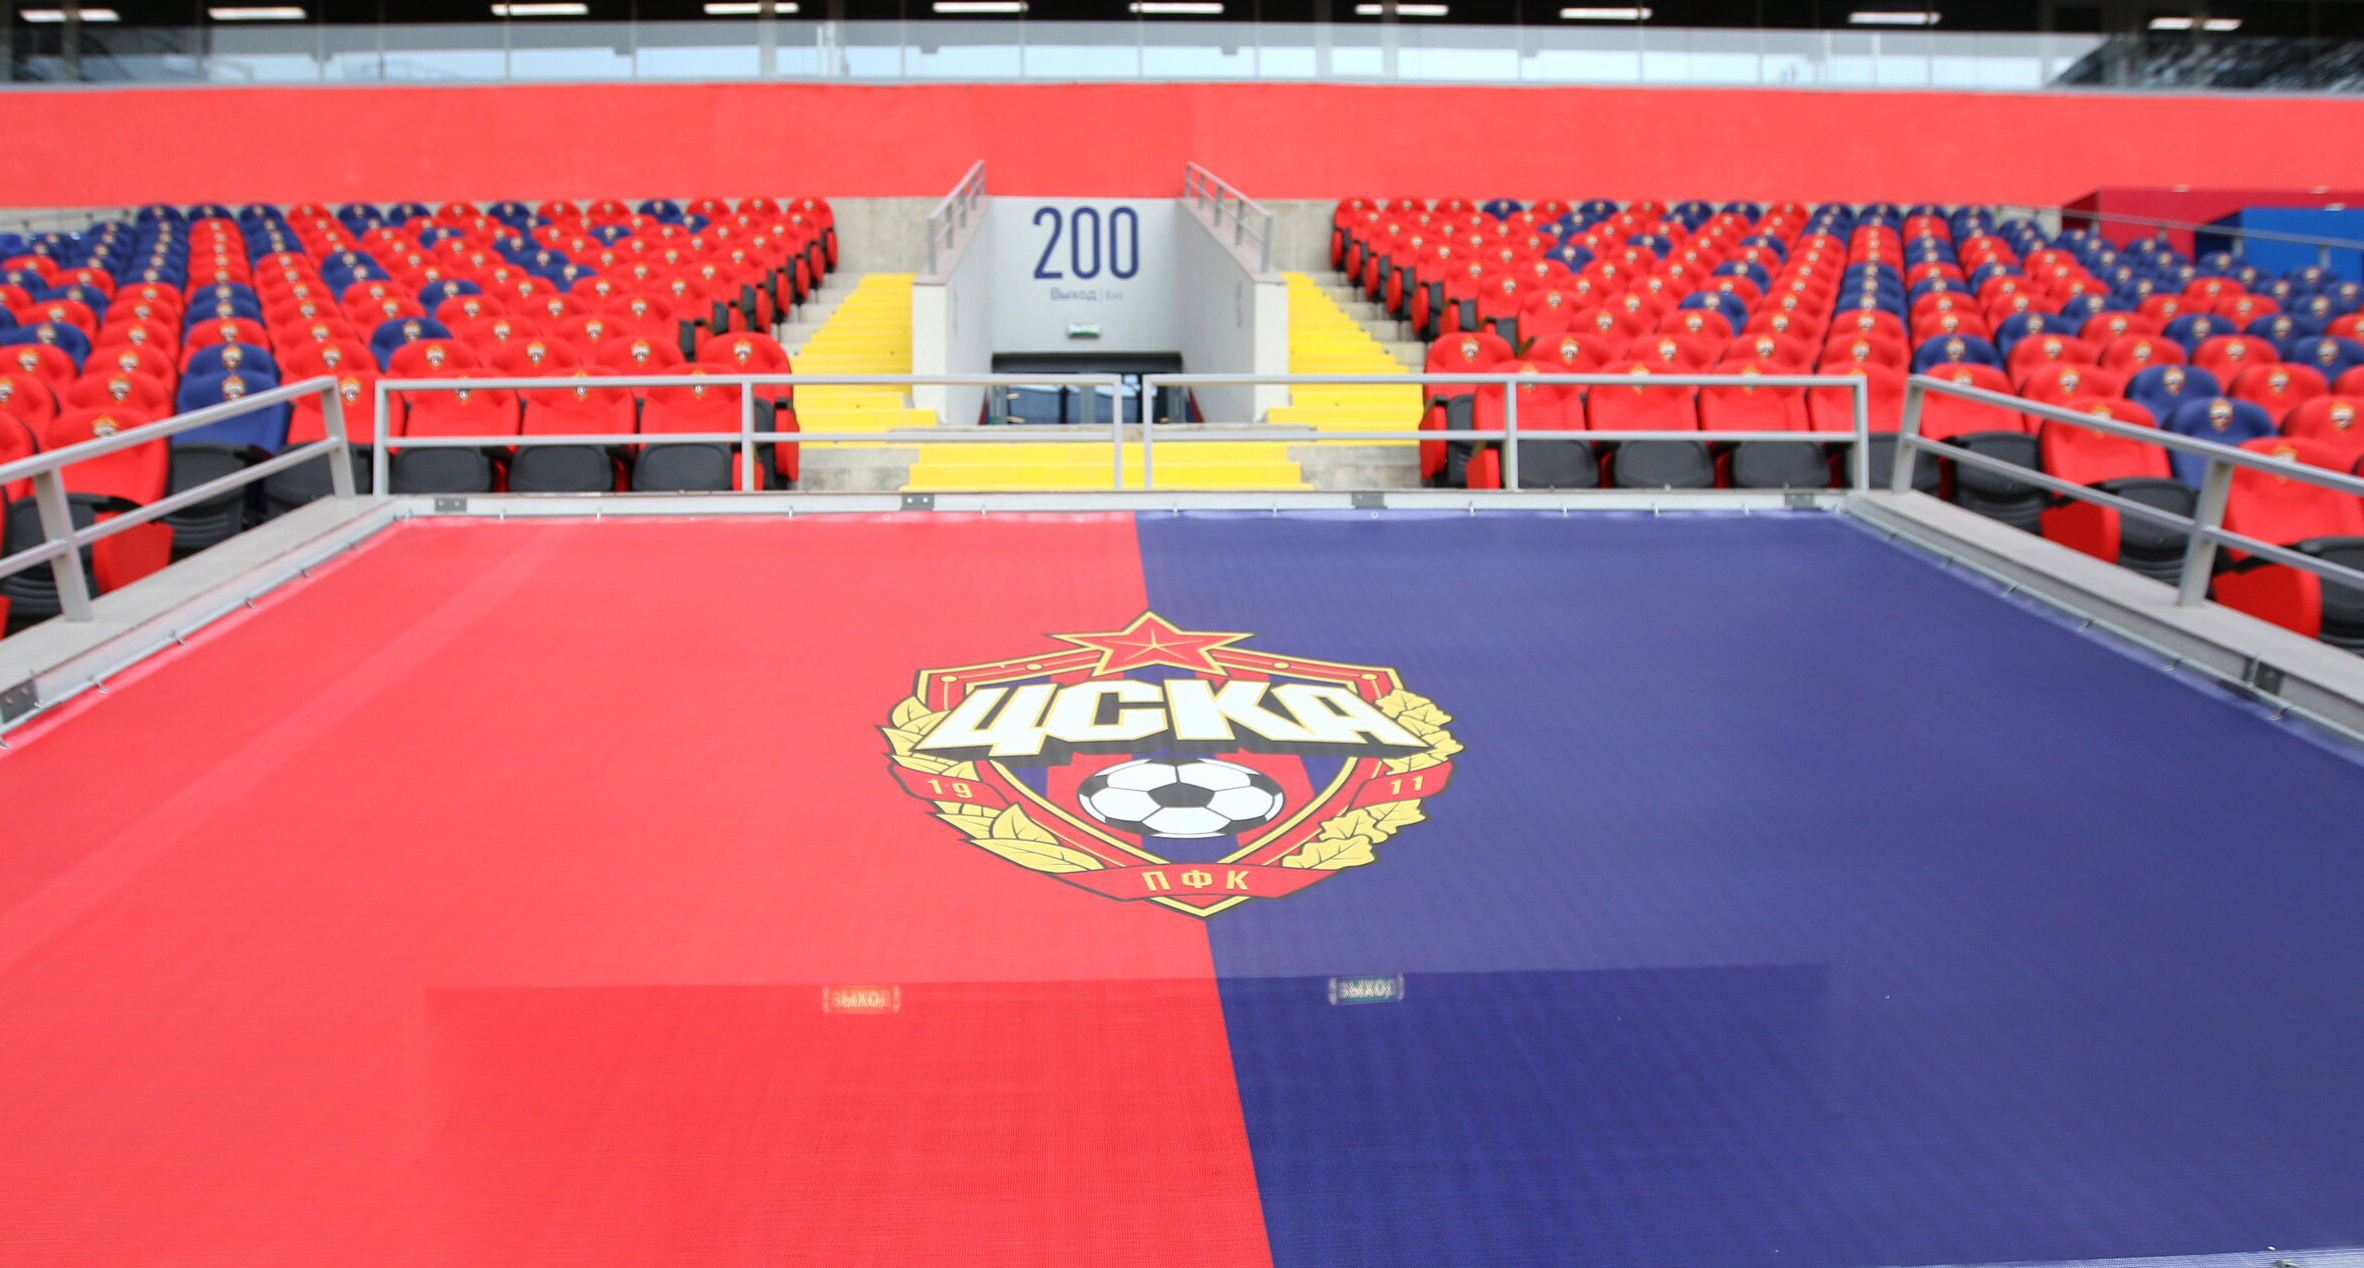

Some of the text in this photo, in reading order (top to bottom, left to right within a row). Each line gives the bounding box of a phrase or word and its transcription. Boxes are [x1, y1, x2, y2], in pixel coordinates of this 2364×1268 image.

[1032, 206, 1139, 279] 200
[1050, 286, 1097, 301] Выход
[908, 678, 1437, 759] ЦСКА
[927, 779, 973, 799] 19
[1390, 775, 1424, 796] 11
[1141, 869, 1250, 891] ПФК
